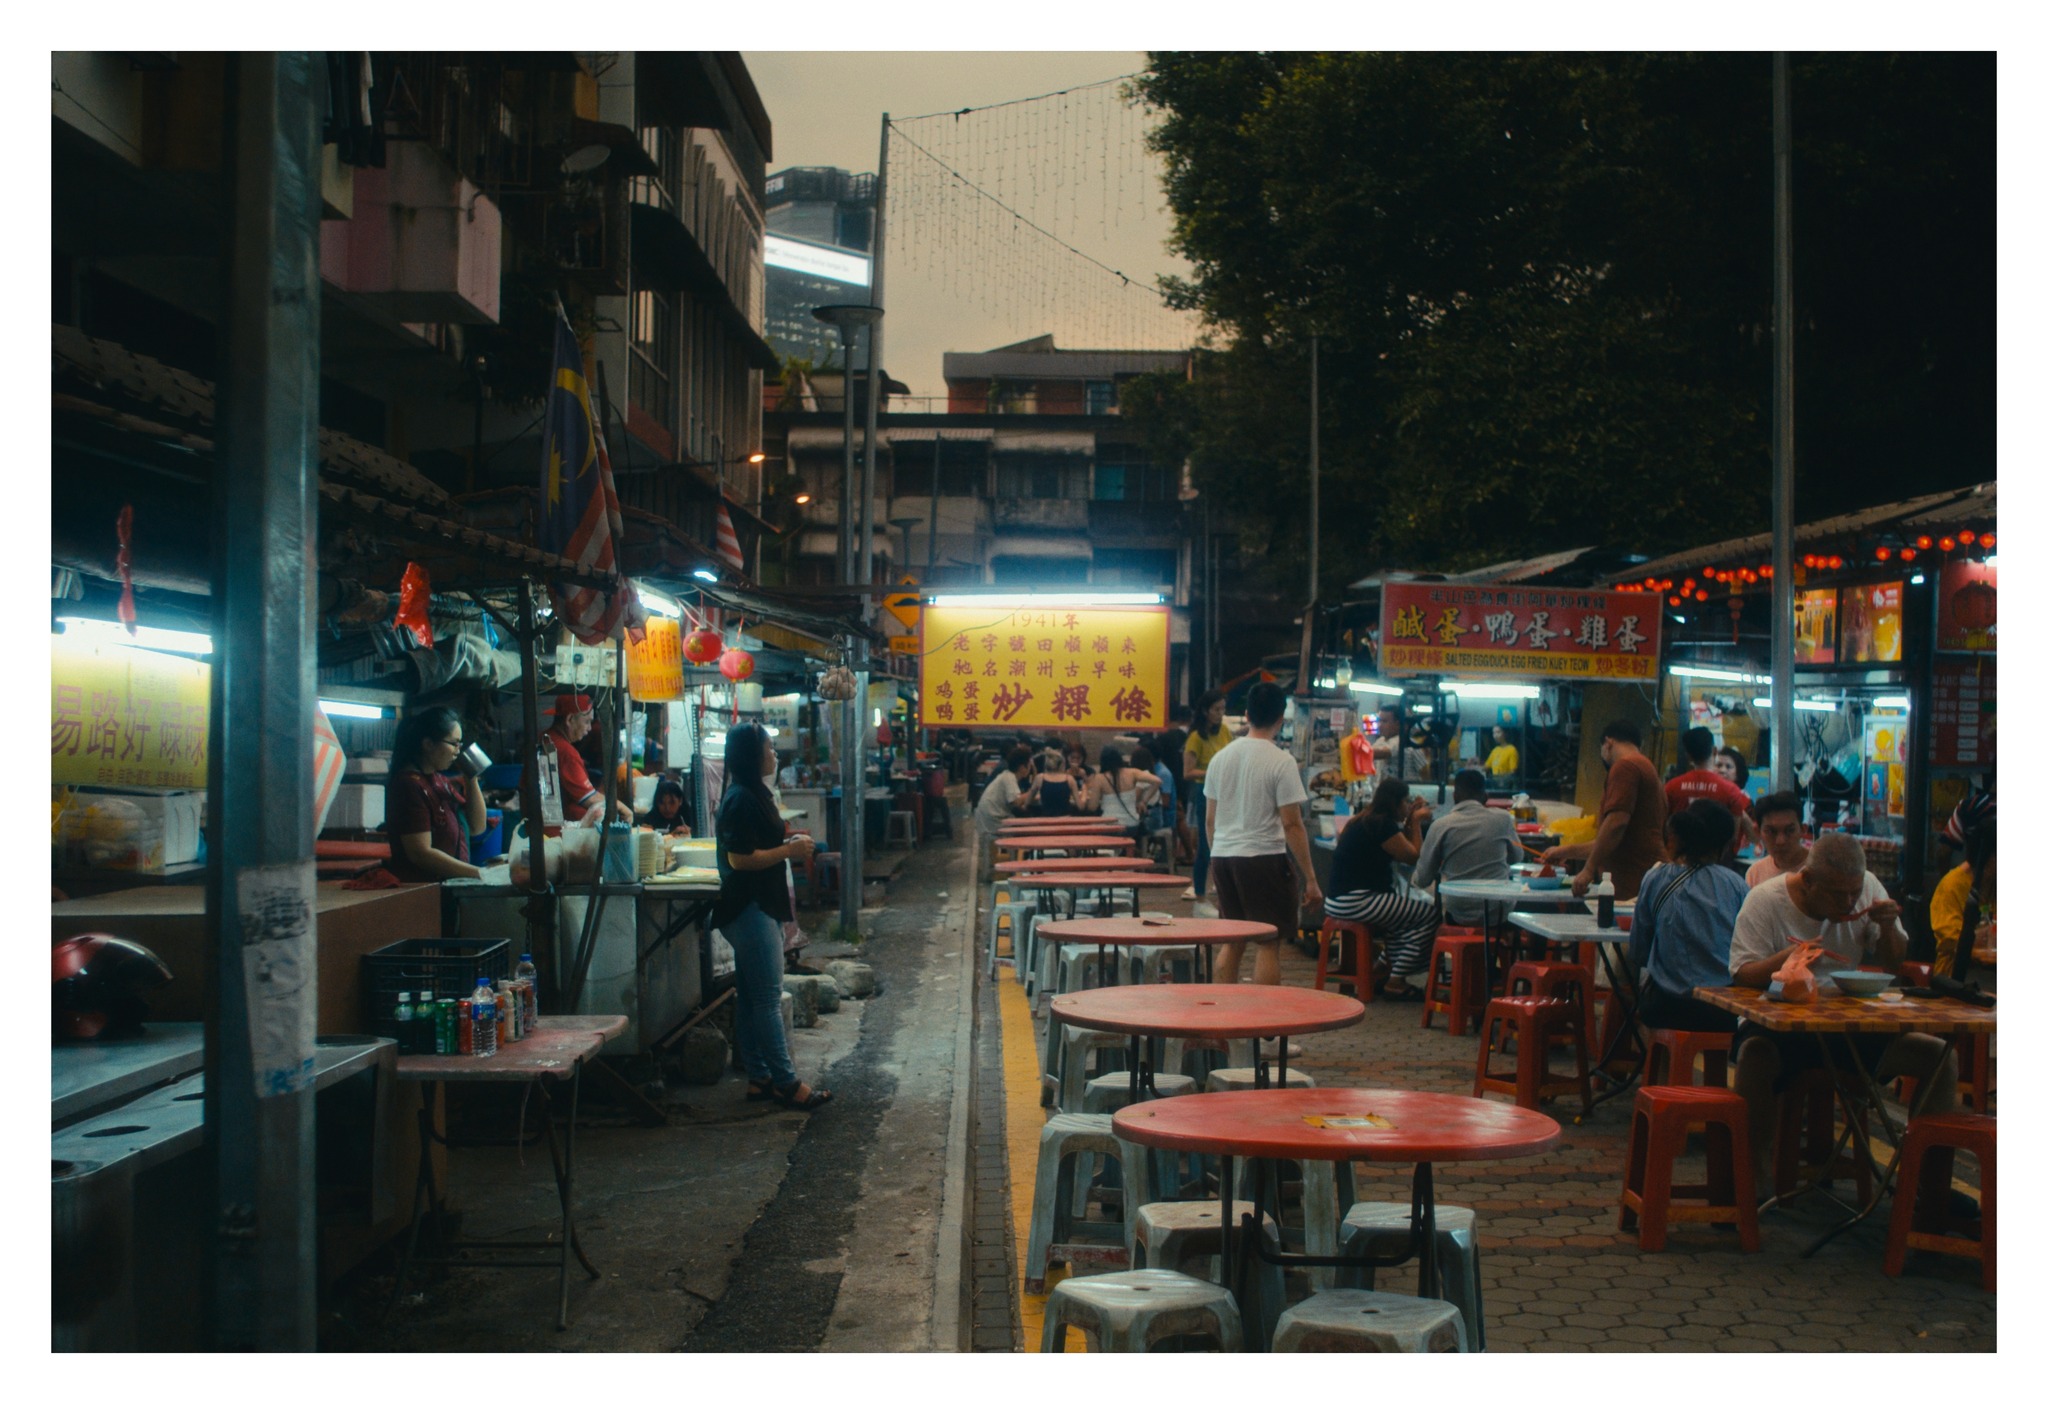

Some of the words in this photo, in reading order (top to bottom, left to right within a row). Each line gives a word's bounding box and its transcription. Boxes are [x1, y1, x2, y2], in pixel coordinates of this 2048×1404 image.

[1010, 612, 1079, 630] 1941年
[1445, 652, 1472, 666] SALTED
[1511, 656, 1527, 669] EGG
[1527, 656, 1548, 670] FRIED
[1549, 657, 1568, 671] KUEY
[1569, 658, 1589, 672] TEOW
[992, 682, 1151, 723] 炒粿條
